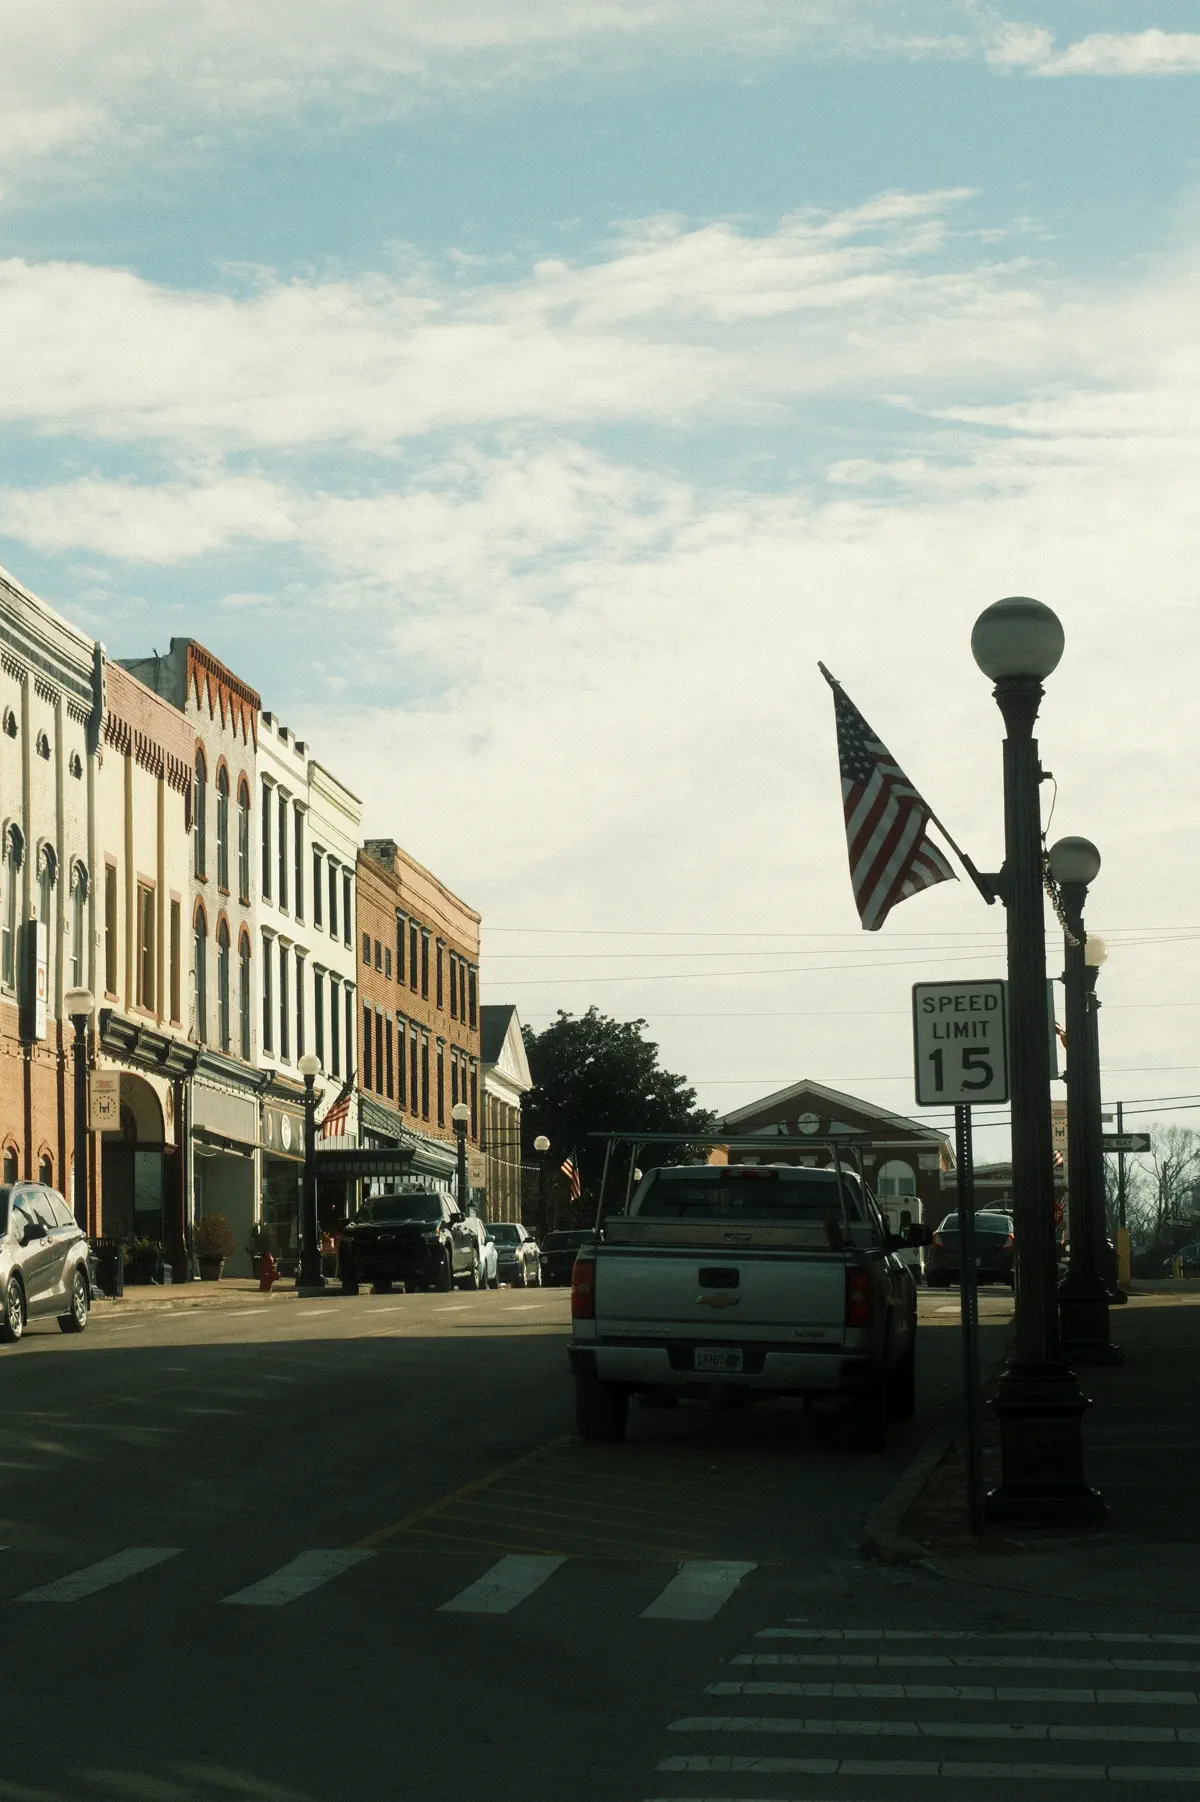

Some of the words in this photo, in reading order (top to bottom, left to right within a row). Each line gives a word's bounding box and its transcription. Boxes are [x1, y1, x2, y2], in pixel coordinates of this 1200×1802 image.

[922, 994, 998, 1013] SPEED
[932, 1021, 990, 1039] LIMIT
[929, 1047, 994, 1092] 15
[1115, 1139, 1133, 1147] WAY
